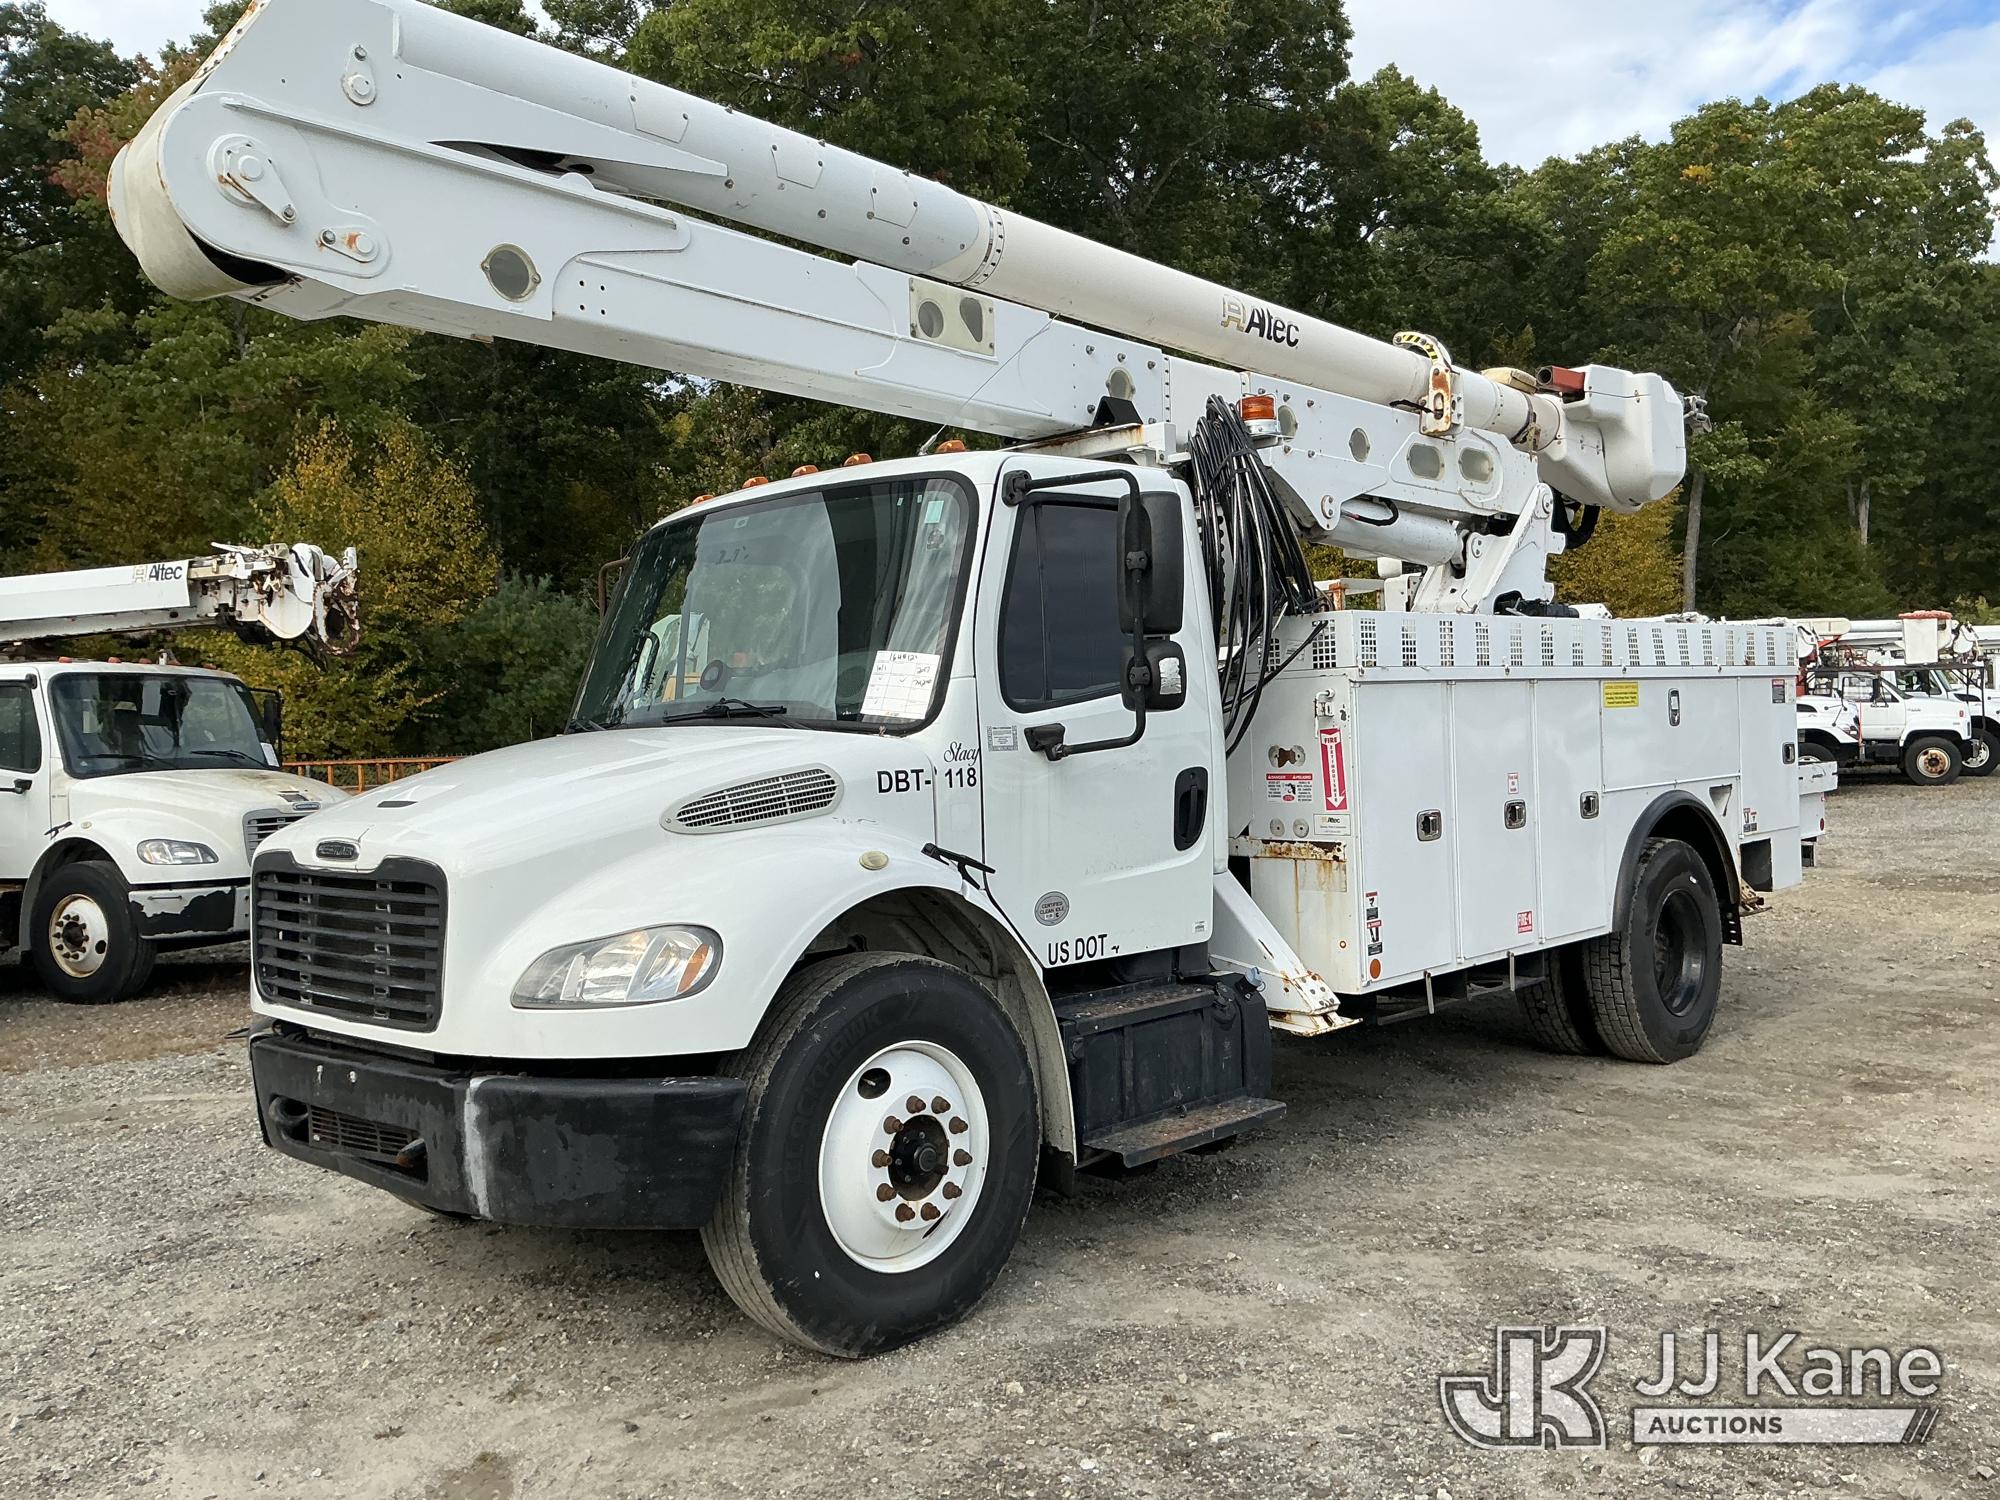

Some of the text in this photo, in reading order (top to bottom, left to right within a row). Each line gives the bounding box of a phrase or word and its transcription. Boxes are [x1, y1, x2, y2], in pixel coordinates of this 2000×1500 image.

[1245, 307, 1299, 348] Altec
[149, 564, 183, 581] Altec
[1324, 736, 1338, 744] FIRE
[943, 741, 980, 766] Stacy
[877, 767, 977, 794] DBT- 118
[1041, 901, 1063, 909] CERTIFIED
[1048, 934, 1108, 965] US DOT
